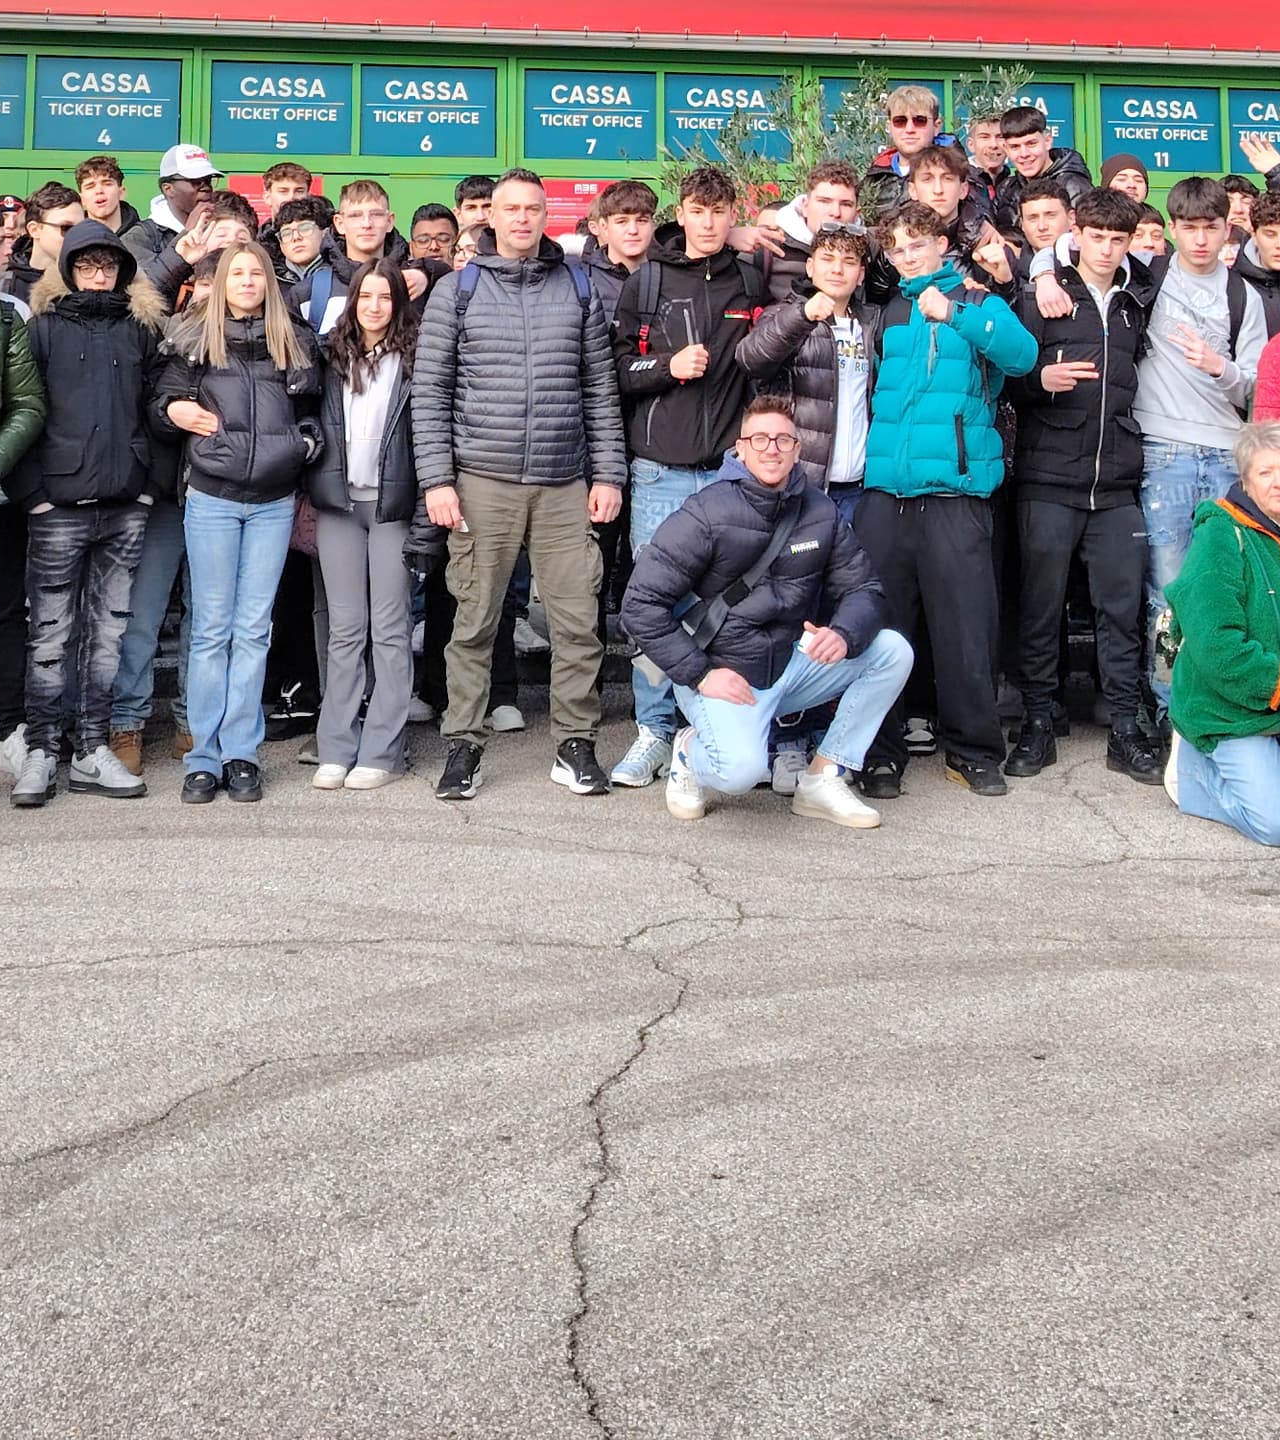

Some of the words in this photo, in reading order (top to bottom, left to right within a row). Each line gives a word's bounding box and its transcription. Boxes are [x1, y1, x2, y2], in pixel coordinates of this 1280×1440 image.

[62, 72, 151, 93] CASSA
[240, 77, 326, 98] CASSA
[384, 80, 468, 101] CASSA
[551, 85, 632, 105] CASSA
[687, 88, 765, 109] CASSA
[49, 102, 102, 117] TICKET
[107, 104, 162, 118] OFFICE
[228, 107, 280, 121] TICKET
[284, 108, 337, 122] OFFICE
[373, 110, 424, 124] TICKET
[428, 111, 479, 124] OFFICE
[1123, 99, 1198, 119] CASSA
[540, 114, 588, 127] TICKET
[592, 115, 642, 128] OFFICE
[676, 117, 724, 129] TICKET
[97, 129, 111, 145] 4
[276, 133, 288, 149] 5
[1114, 127, 1158, 140] TICKET
[1162, 129, 1208, 141] OFFICE
[420, 135, 432, 152] 6
[586, 139, 597, 154] 7
[1154, 152, 1169, 168] 11
